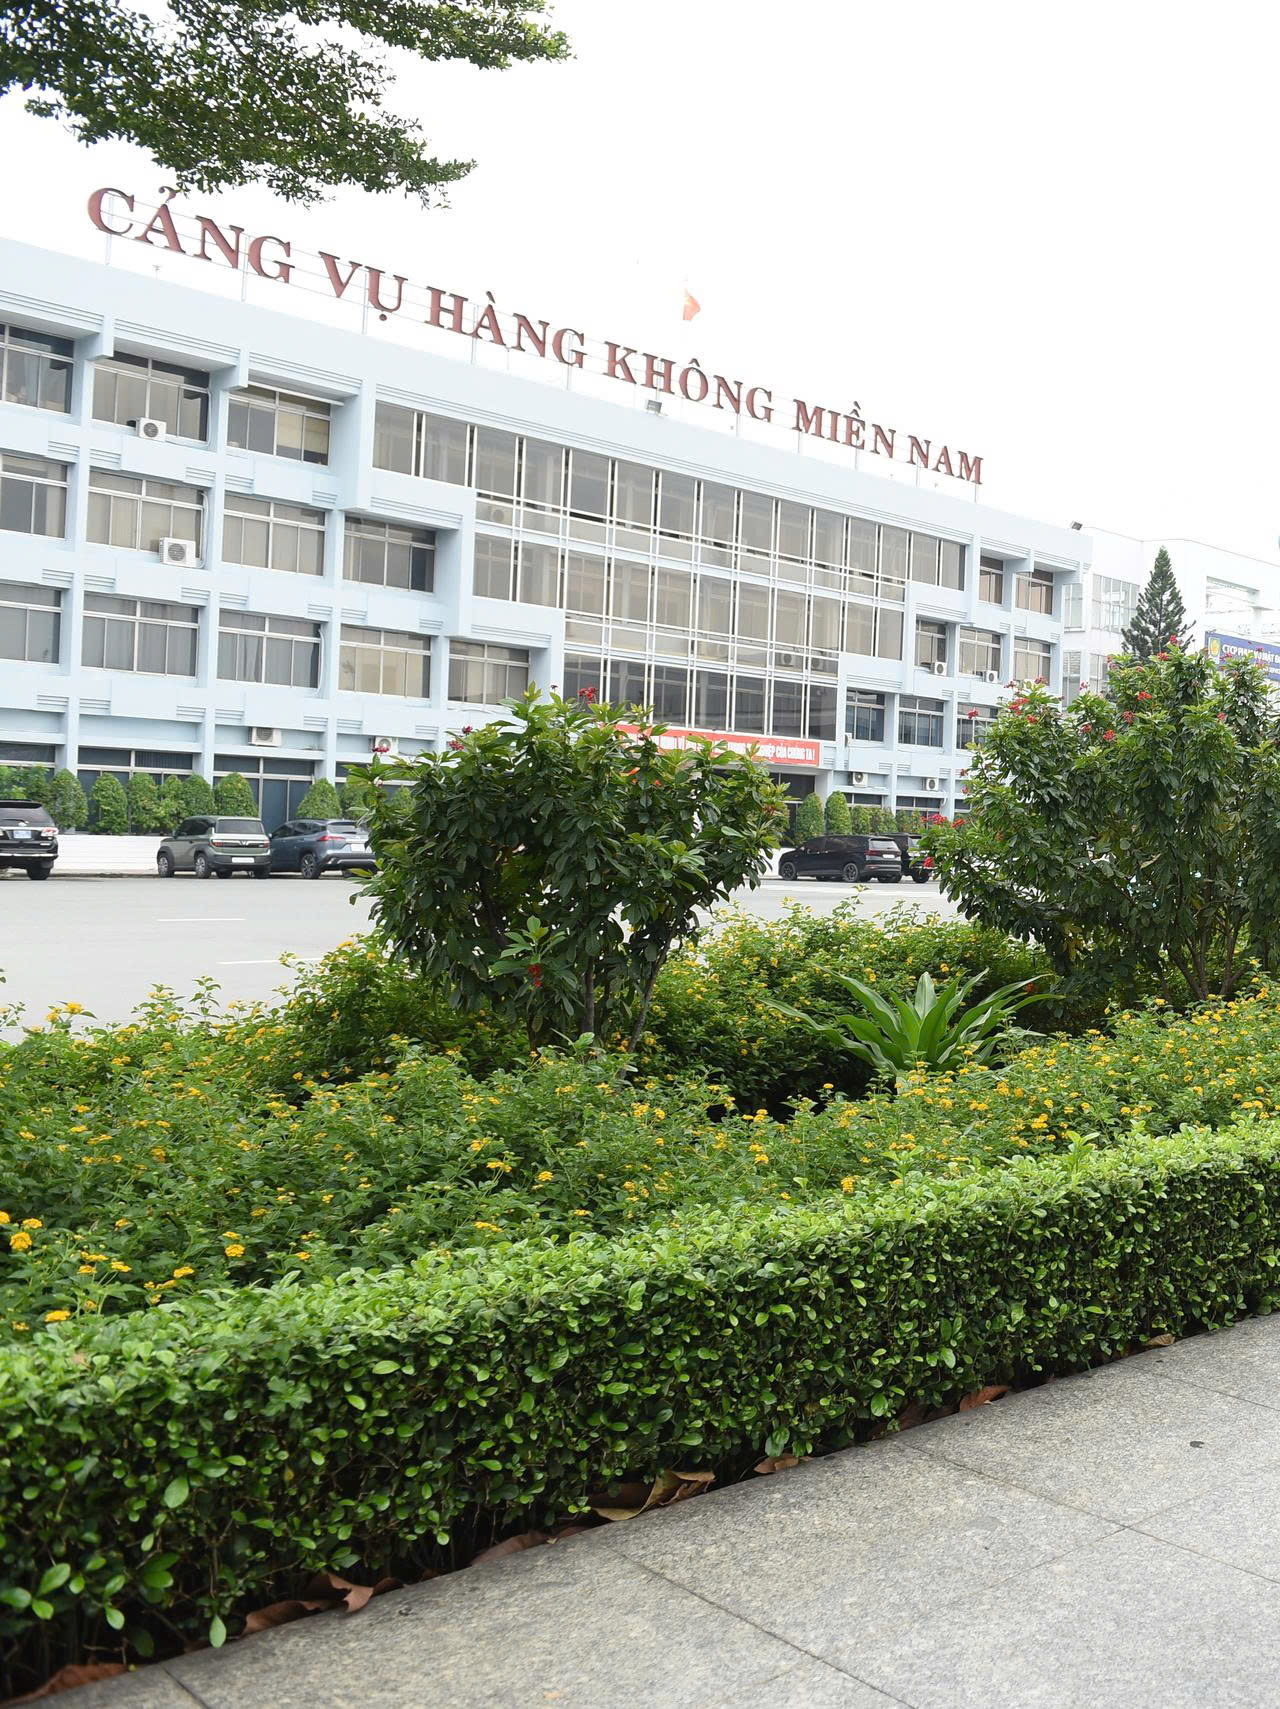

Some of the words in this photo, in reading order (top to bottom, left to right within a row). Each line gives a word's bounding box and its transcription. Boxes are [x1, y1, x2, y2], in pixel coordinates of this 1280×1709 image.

[87, 186, 295, 284] CẢNG
[318, 251, 408, 321] VỤ
[425, 286, 588, 369] HÀNG
[603, 341, 775, 424] KHÔNG
[792, 399, 897, 459] MIỀN
[906, 434, 984, 485] NAM
